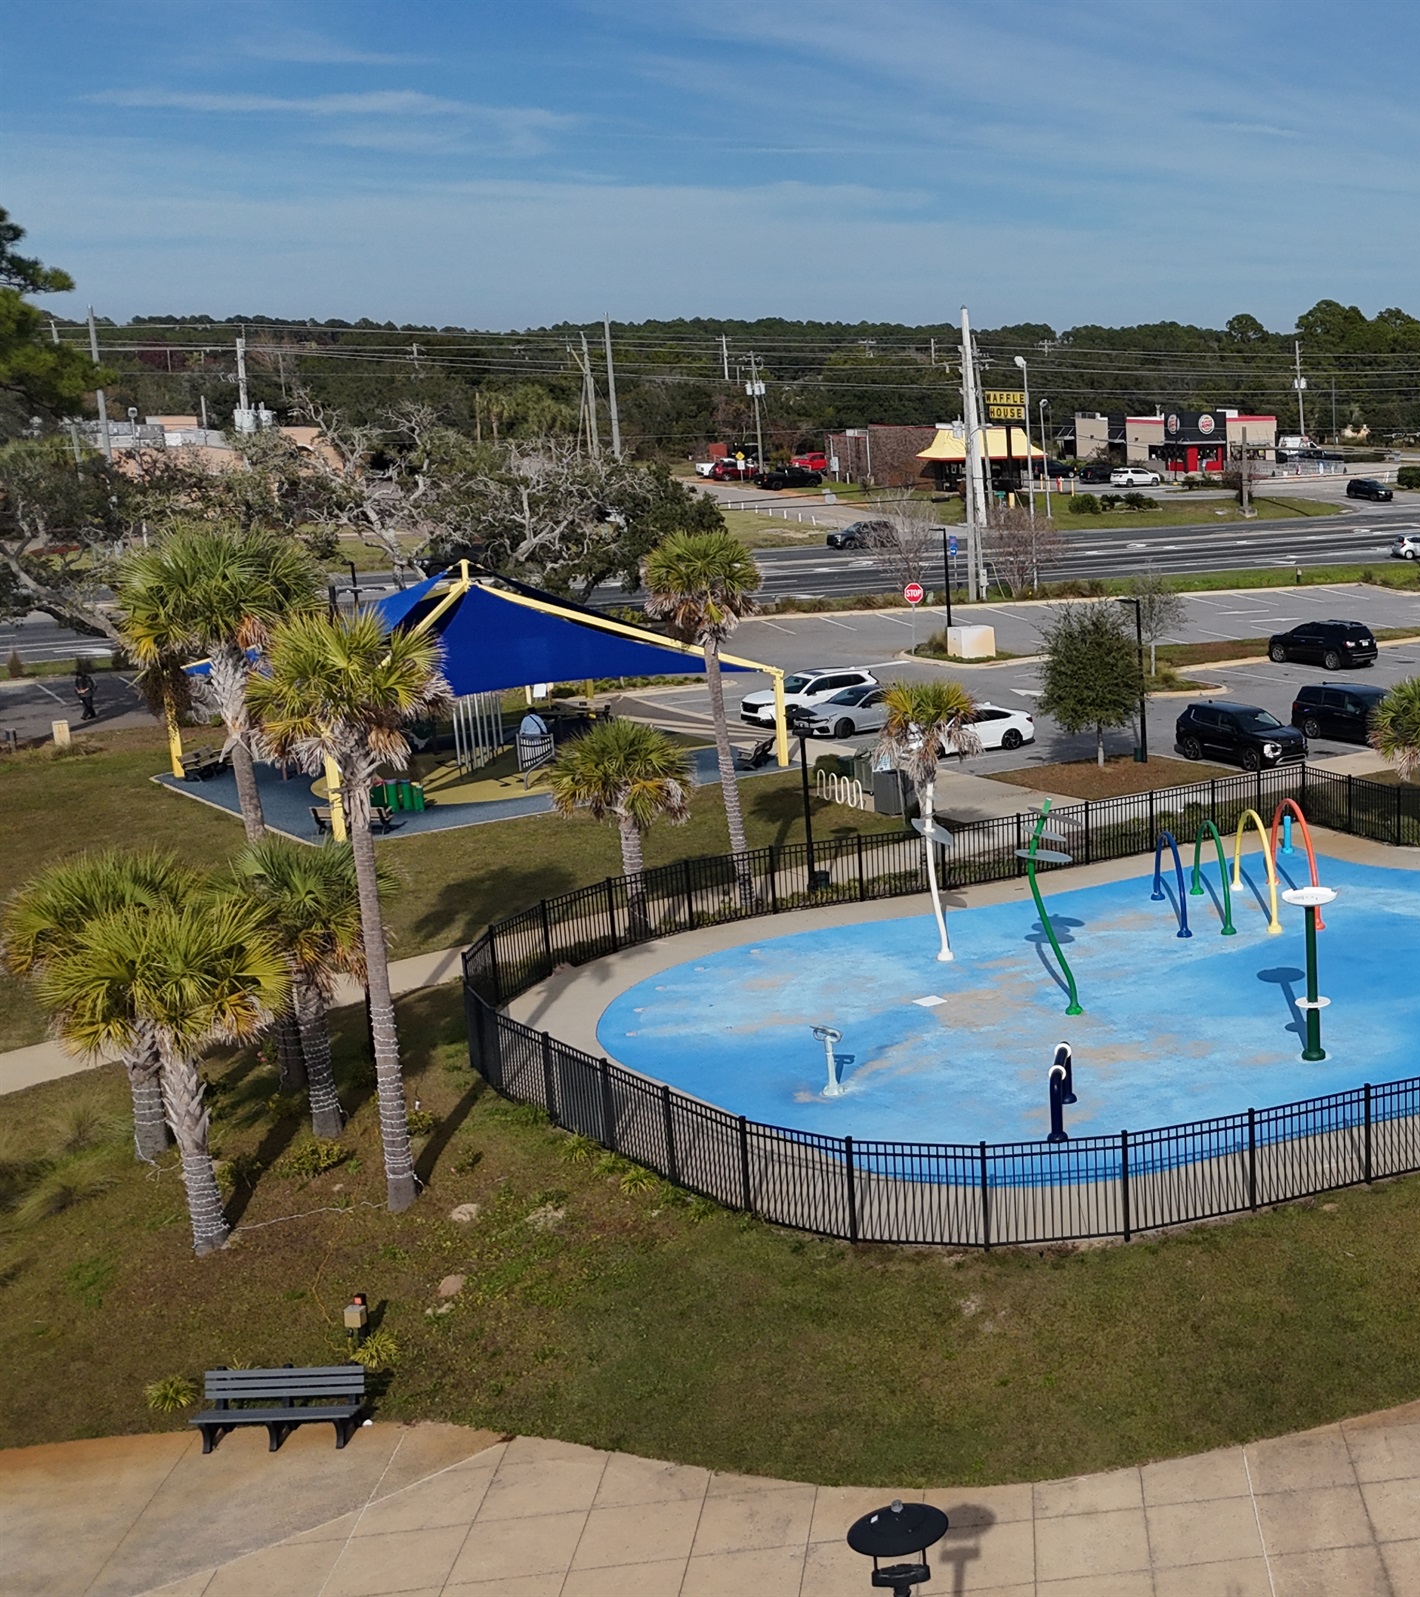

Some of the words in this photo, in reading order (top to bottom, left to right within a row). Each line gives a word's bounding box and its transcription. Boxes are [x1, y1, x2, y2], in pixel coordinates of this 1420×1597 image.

[986, 393, 1025, 403] WAFFLE
[990, 407, 1022, 417] HOUSE
[906, 589, 921, 597] STOP
